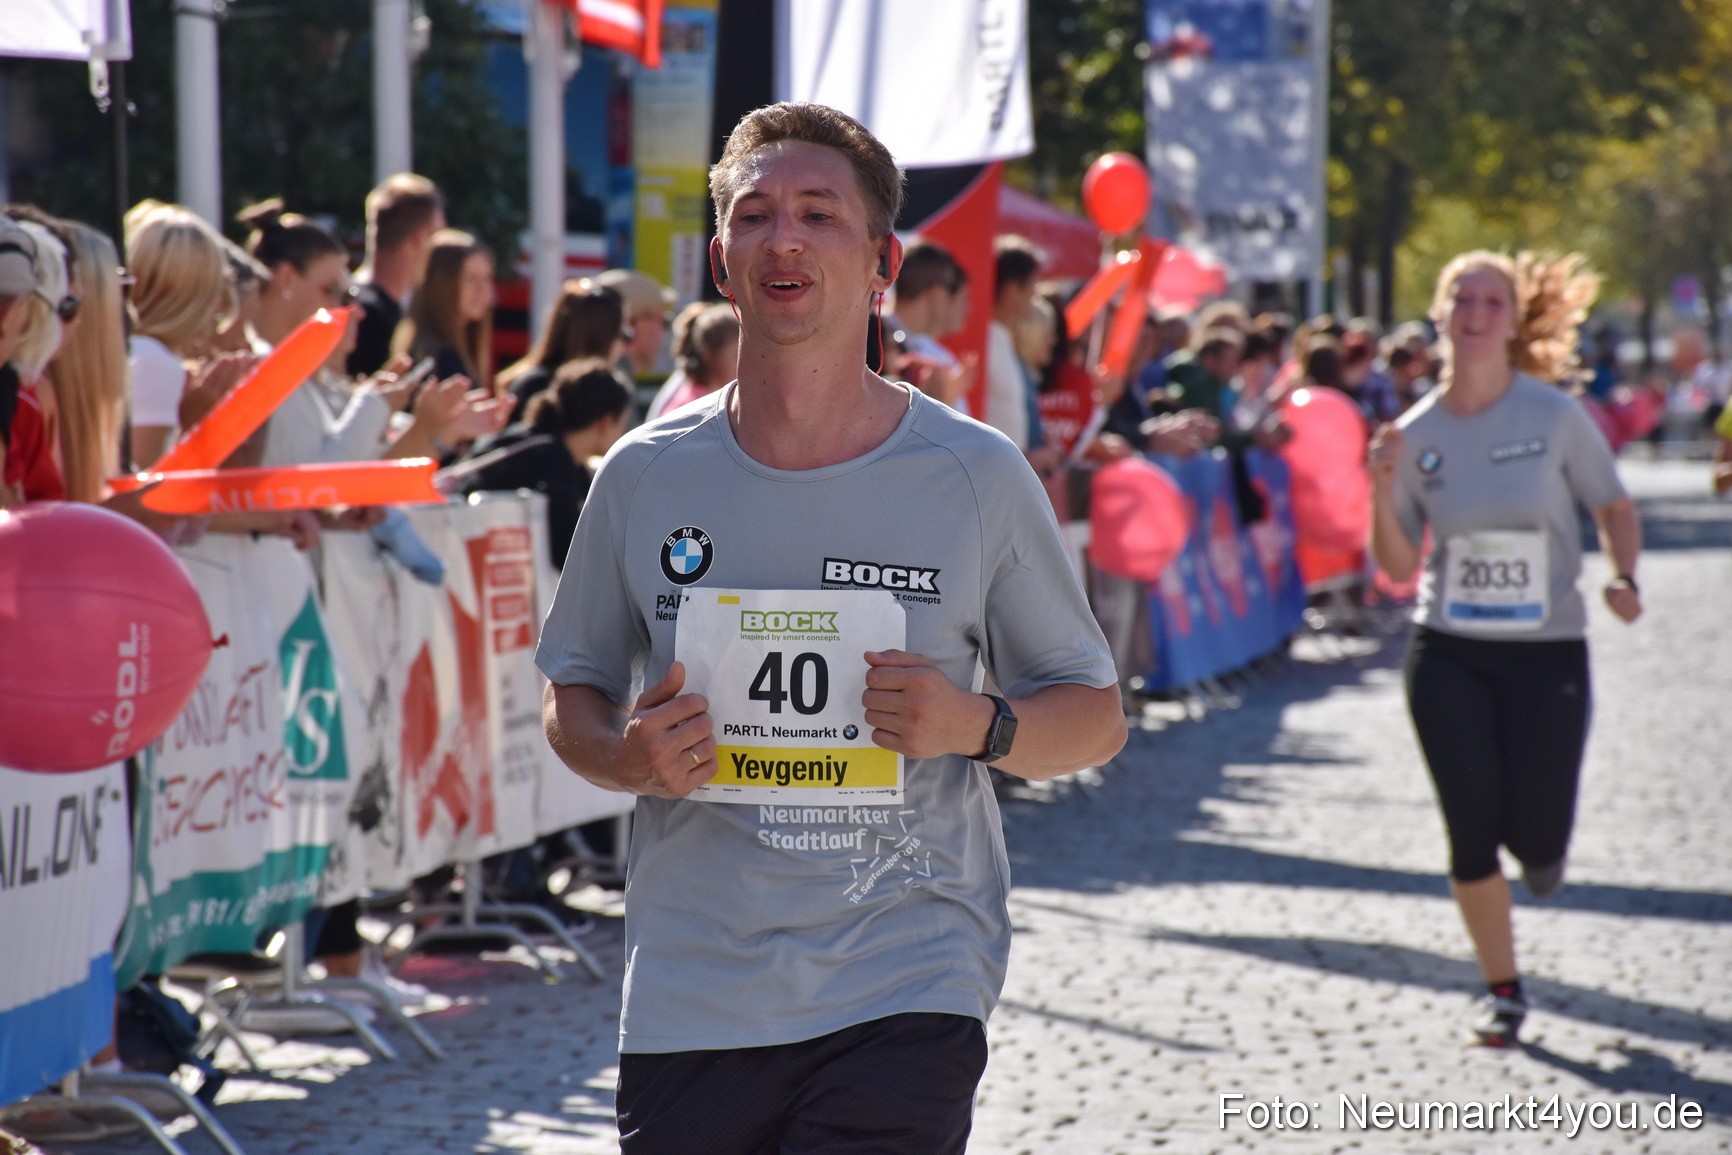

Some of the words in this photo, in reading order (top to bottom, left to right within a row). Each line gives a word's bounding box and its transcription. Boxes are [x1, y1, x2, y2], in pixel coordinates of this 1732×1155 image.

[666, 528, 709, 547] BMW
[822, 557, 941, 595] BOCK
[1459, 558, 1530, 590] 2033
[902, 593, 941, 605] concepts
[741, 610, 839, 633] BOCK
[740, 633, 770, 641] inspired
[749, 652, 829, 715] 40
[723, 724, 769, 737] PARTL
[771, 726, 838, 739] Neumarkt
[731, 752, 848, 787] Yevgeniy
[759, 804, 890, 824] Neumarkter
[757, 828, 868, 850] Stadtlauf
[849, 892, 864, 904] 16.
[860, 852, 901, 895] September
[899, 837, 921, 857] 2018
